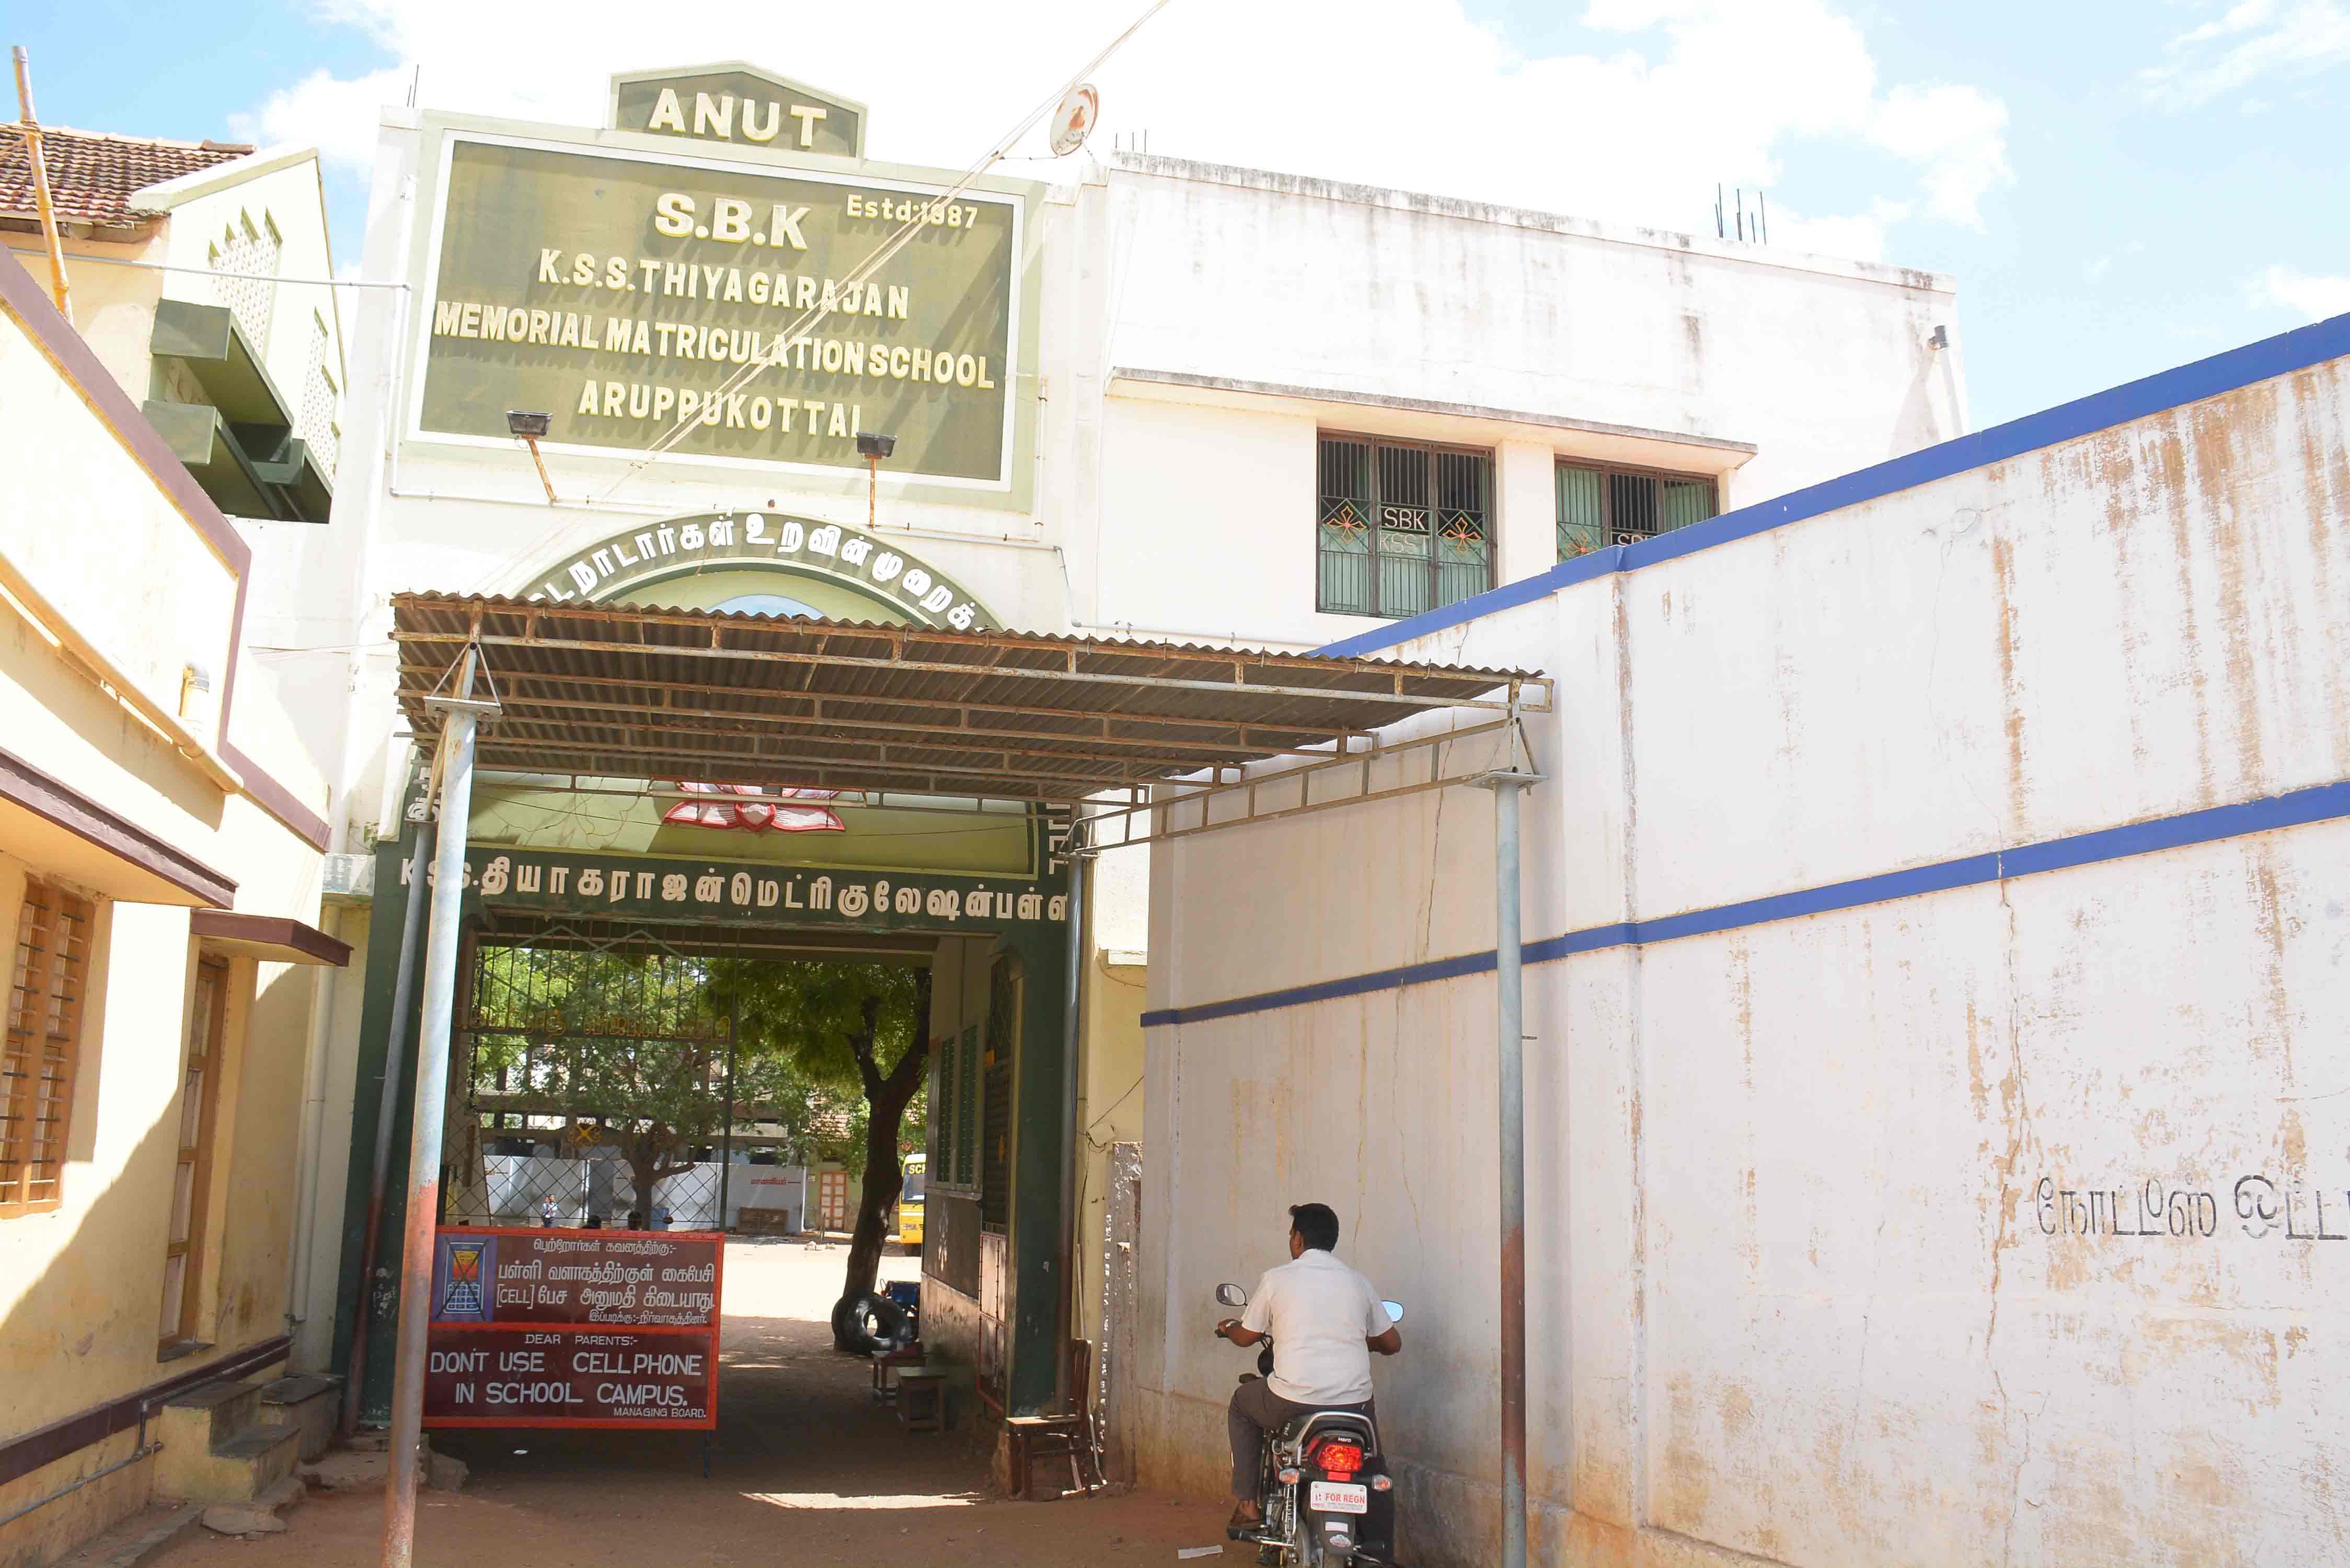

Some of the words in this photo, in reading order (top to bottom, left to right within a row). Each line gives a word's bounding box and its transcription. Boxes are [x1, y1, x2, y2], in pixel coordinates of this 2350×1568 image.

[649, 88, 827, 148] ANUT
[654, 192, 810, 251] S.B.K
[434, 300, 599, 350] MEMORIAL
[868, 343, 996, 390] SCHOOL
[578, 380, 861, 438] ARUPPUKOTTAI
[1384, 508, 1425, 531] SBK
[498, 1259, 542, 1280] பள்ளி
[662, 1263, 715, 1282] கைபேசி
[538, 1286, 568, 1305] பேச
[580, 1285, 636, 1309] அனுமதி
[525, 1334, 561, 1344] DEAR
[430, 1348, 490, 1373] DON'T
[499, 1352, 545, 1372] USE
[455, 1383, 475, 1403] IN
[486, 1382, 583, 1403] SCHOOL
[597, 1383, 687, 1406] CAMPUS.
[614, 1407, 667, 1417] MANAGING
[1326, 1492, 1341, 1502] FOR
[1343, 1494, 1365, 1504] REGN
